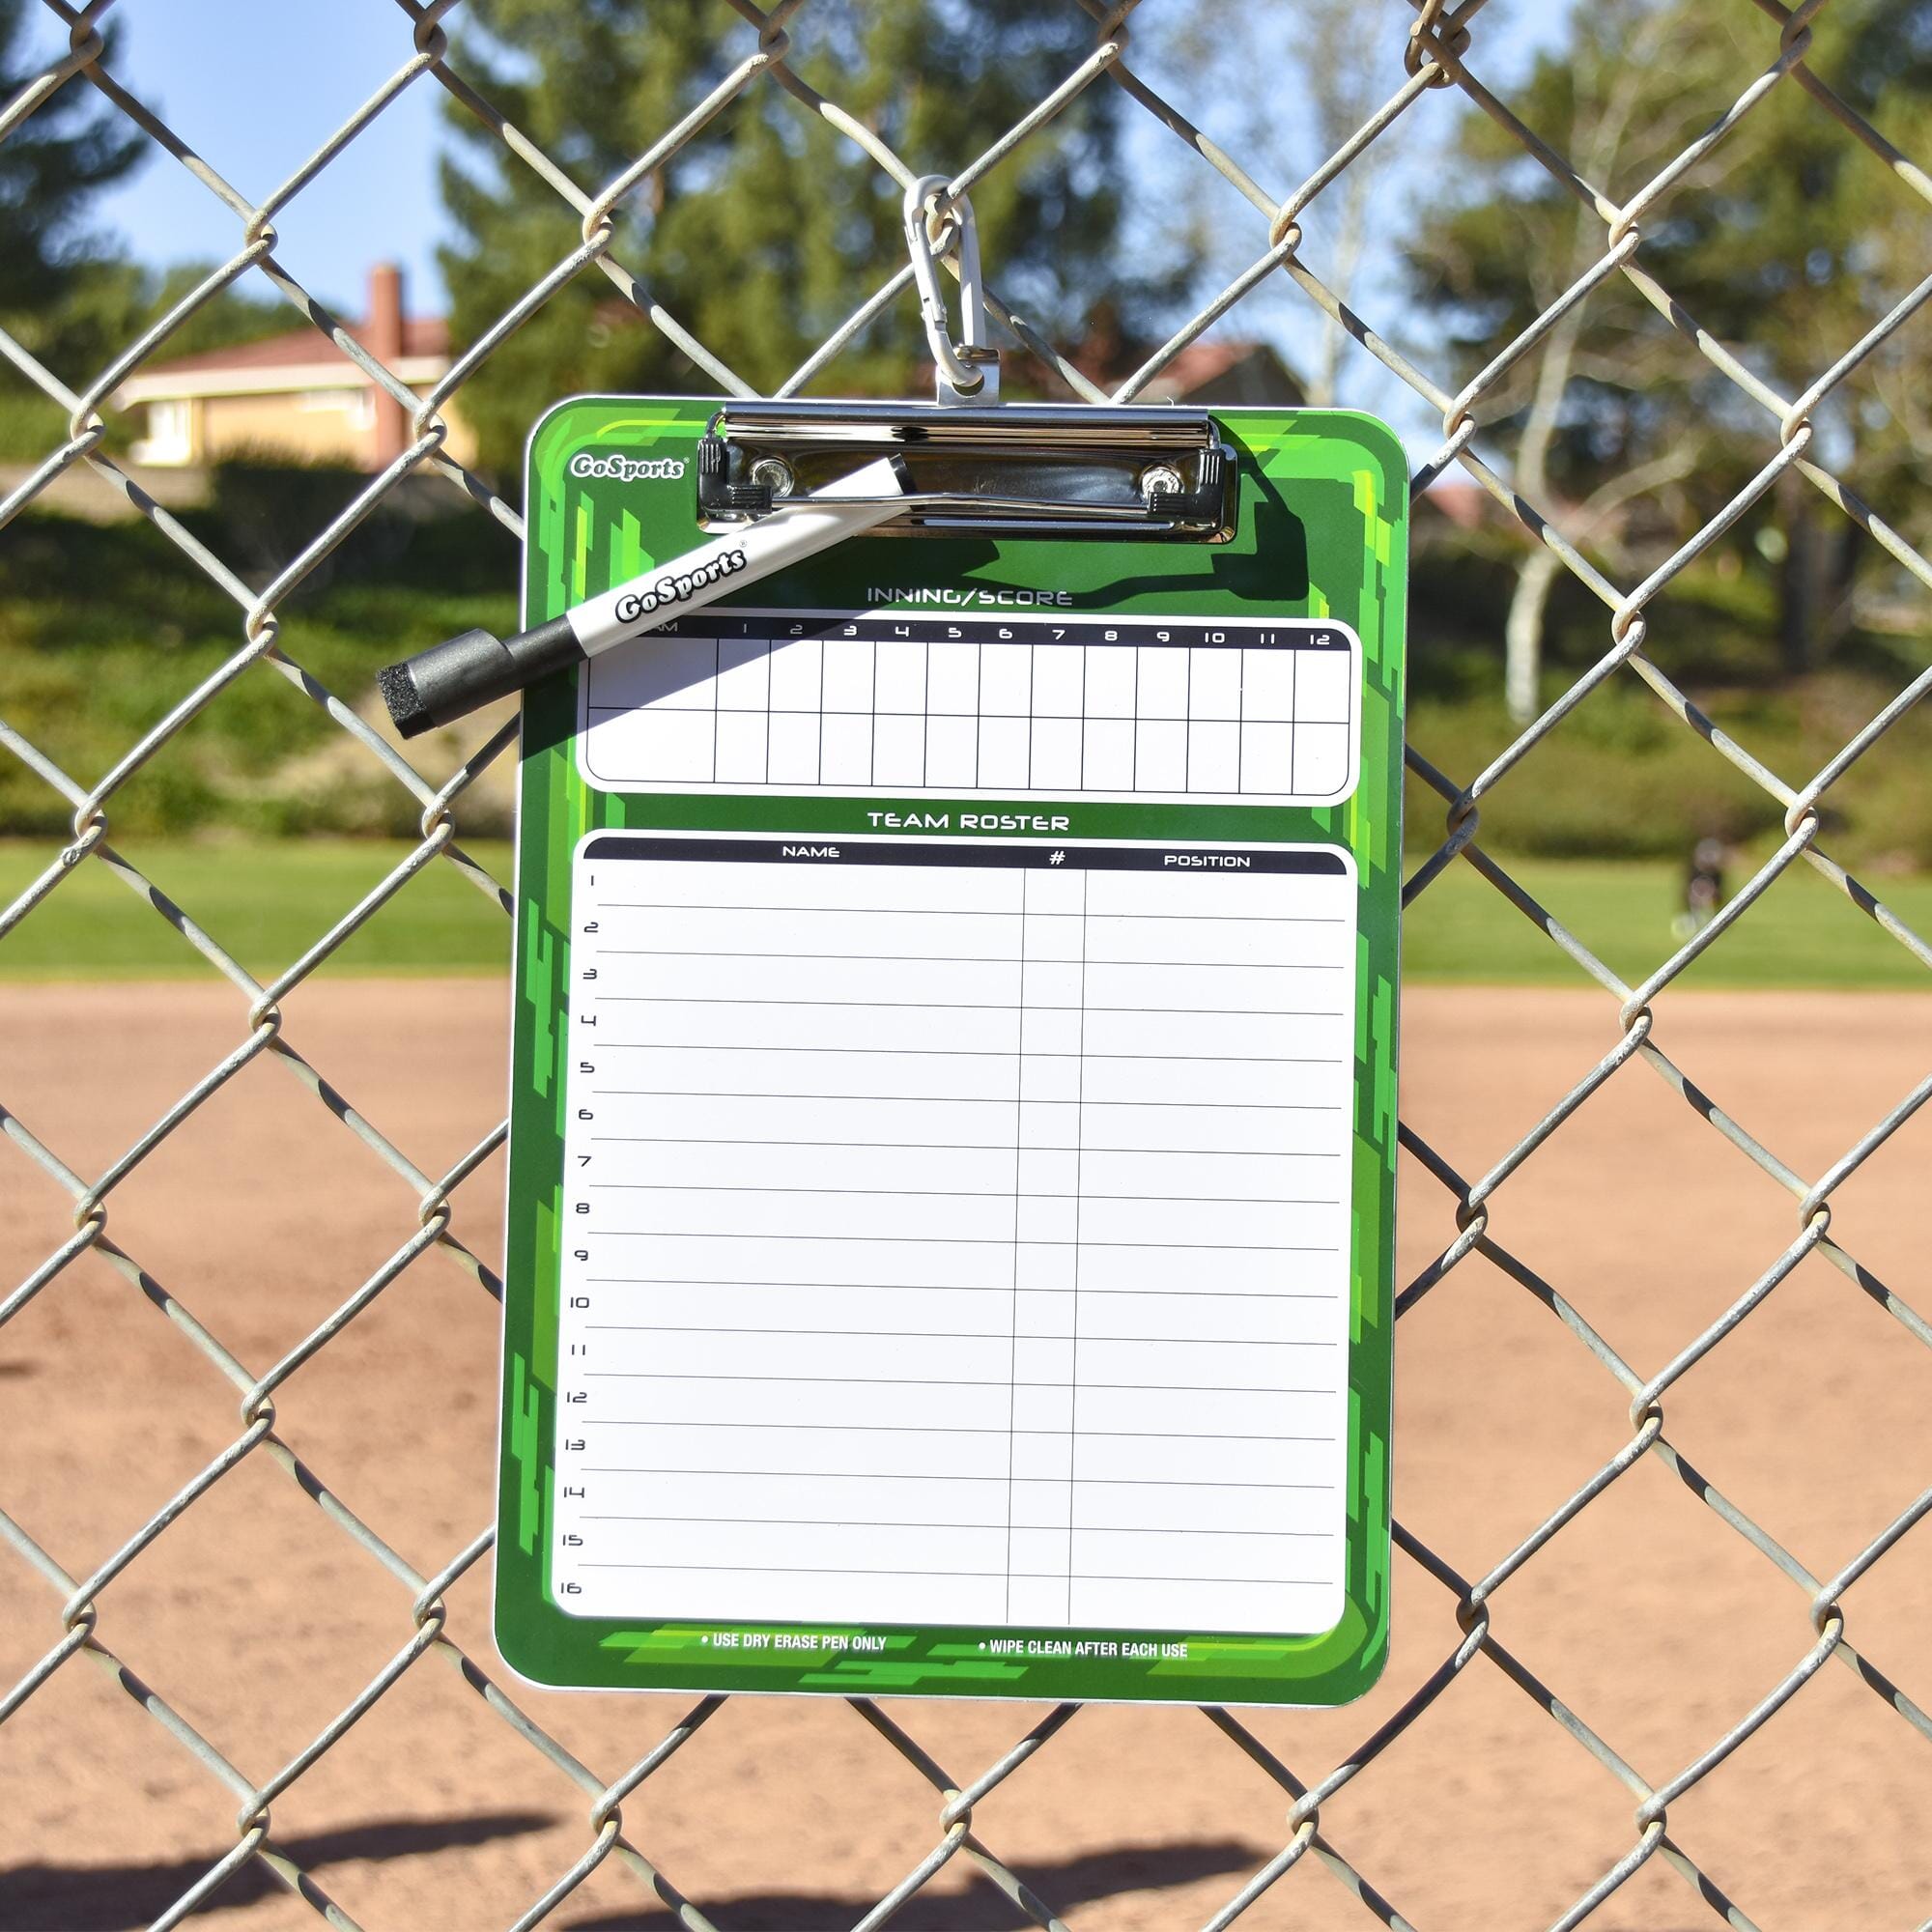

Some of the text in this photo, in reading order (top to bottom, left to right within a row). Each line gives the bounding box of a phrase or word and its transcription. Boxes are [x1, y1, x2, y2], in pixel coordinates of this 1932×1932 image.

[867, 587, 1072, 607] INNING/SCORE
[789, 624, 803, 635] 2
[843, 625, 858, 637] 3
[895, 626, 910, 638] 4
[948, 627, 962, 639] 5
[999, 628, 1013, 639] 6
[1052, 629, 1065, 640] 7
[1104, 630, 1118, 641] 8
[1156, 631, 1170, 642] 9
[1205, 632, 1225, 643] 10
[1260, 633, 1275, 644] 11
[1310, 634, 1330, 645] 12
[867, 811, 1069, 831] TEAM ROSTER
[782, 845, 1251, 867] NAME # POSITION
[583, 921, 599, 933] 2
[582, 968, 598, 980] 3
[581, 1014, 597, 1027] 4
[580, 1062, 595, 1074] 5
[578, 1108, 594, 1121] 6
[577, 1155, 592, 1168] 7
[576, 1203, 590, 1214] 8
[574, 1249, 589, 1262] 9
[570, 1296, 590, 1309] 10
[571, 1344, 586, 1355] 11
[566, 1391, 587, 1404] 12
[565, 1438, 586, 1451] 13
[563, 1486, 585, 1498] 14
[562, 1534, 583, 1547] 15
[560, 1582, 582, 1595] 16
[713, 1633, 887, 1651] USE DRY ERASE PEN ONLY
[989, 1639, 1188, 1658] WIPE CLEAN AFTER EACH USE
